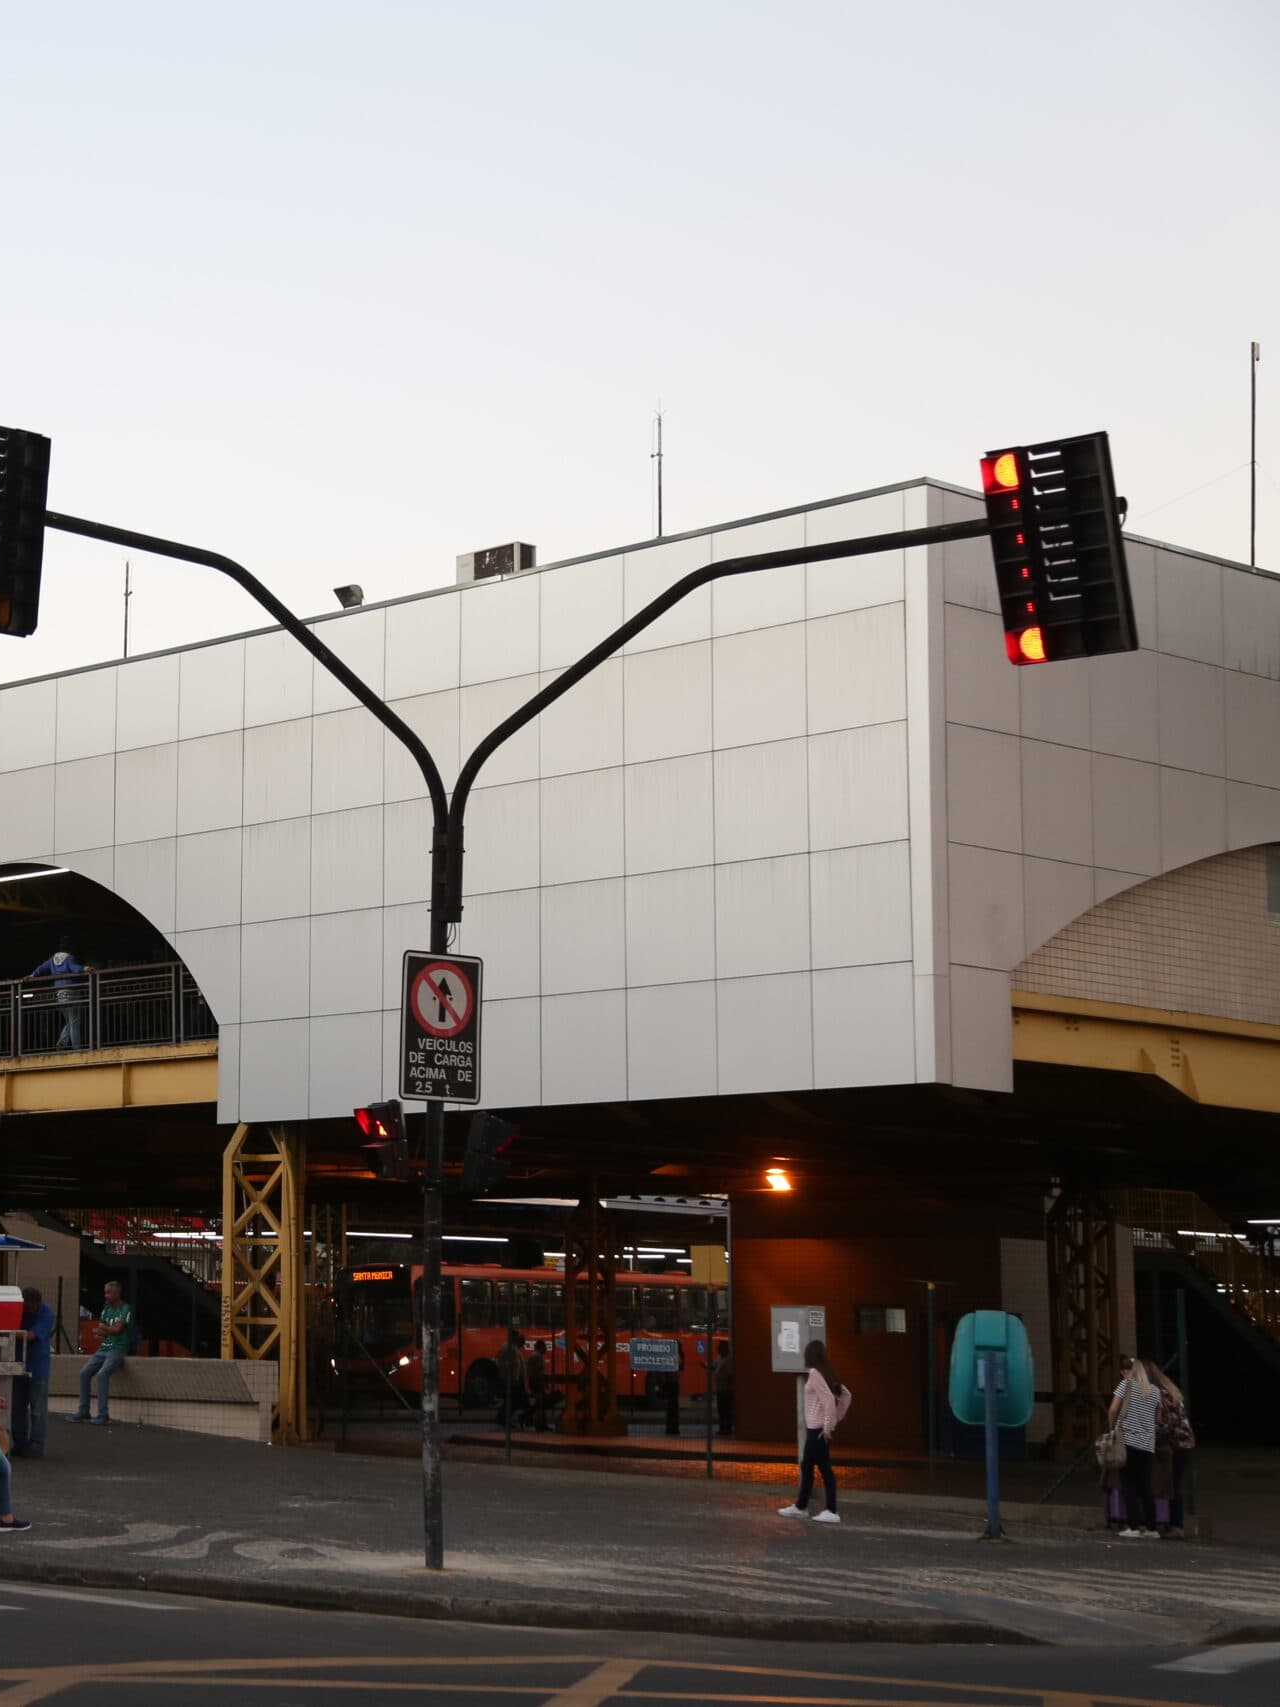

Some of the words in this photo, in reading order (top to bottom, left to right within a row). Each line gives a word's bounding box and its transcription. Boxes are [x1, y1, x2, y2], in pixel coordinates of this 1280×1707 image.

[409, 1052, 426, 1064] DE
[434, 1053, 472, 1068] CARGA
[409, 1066, 447, 1080] ACIMA
[458, 1070, 472, 1082] DE
